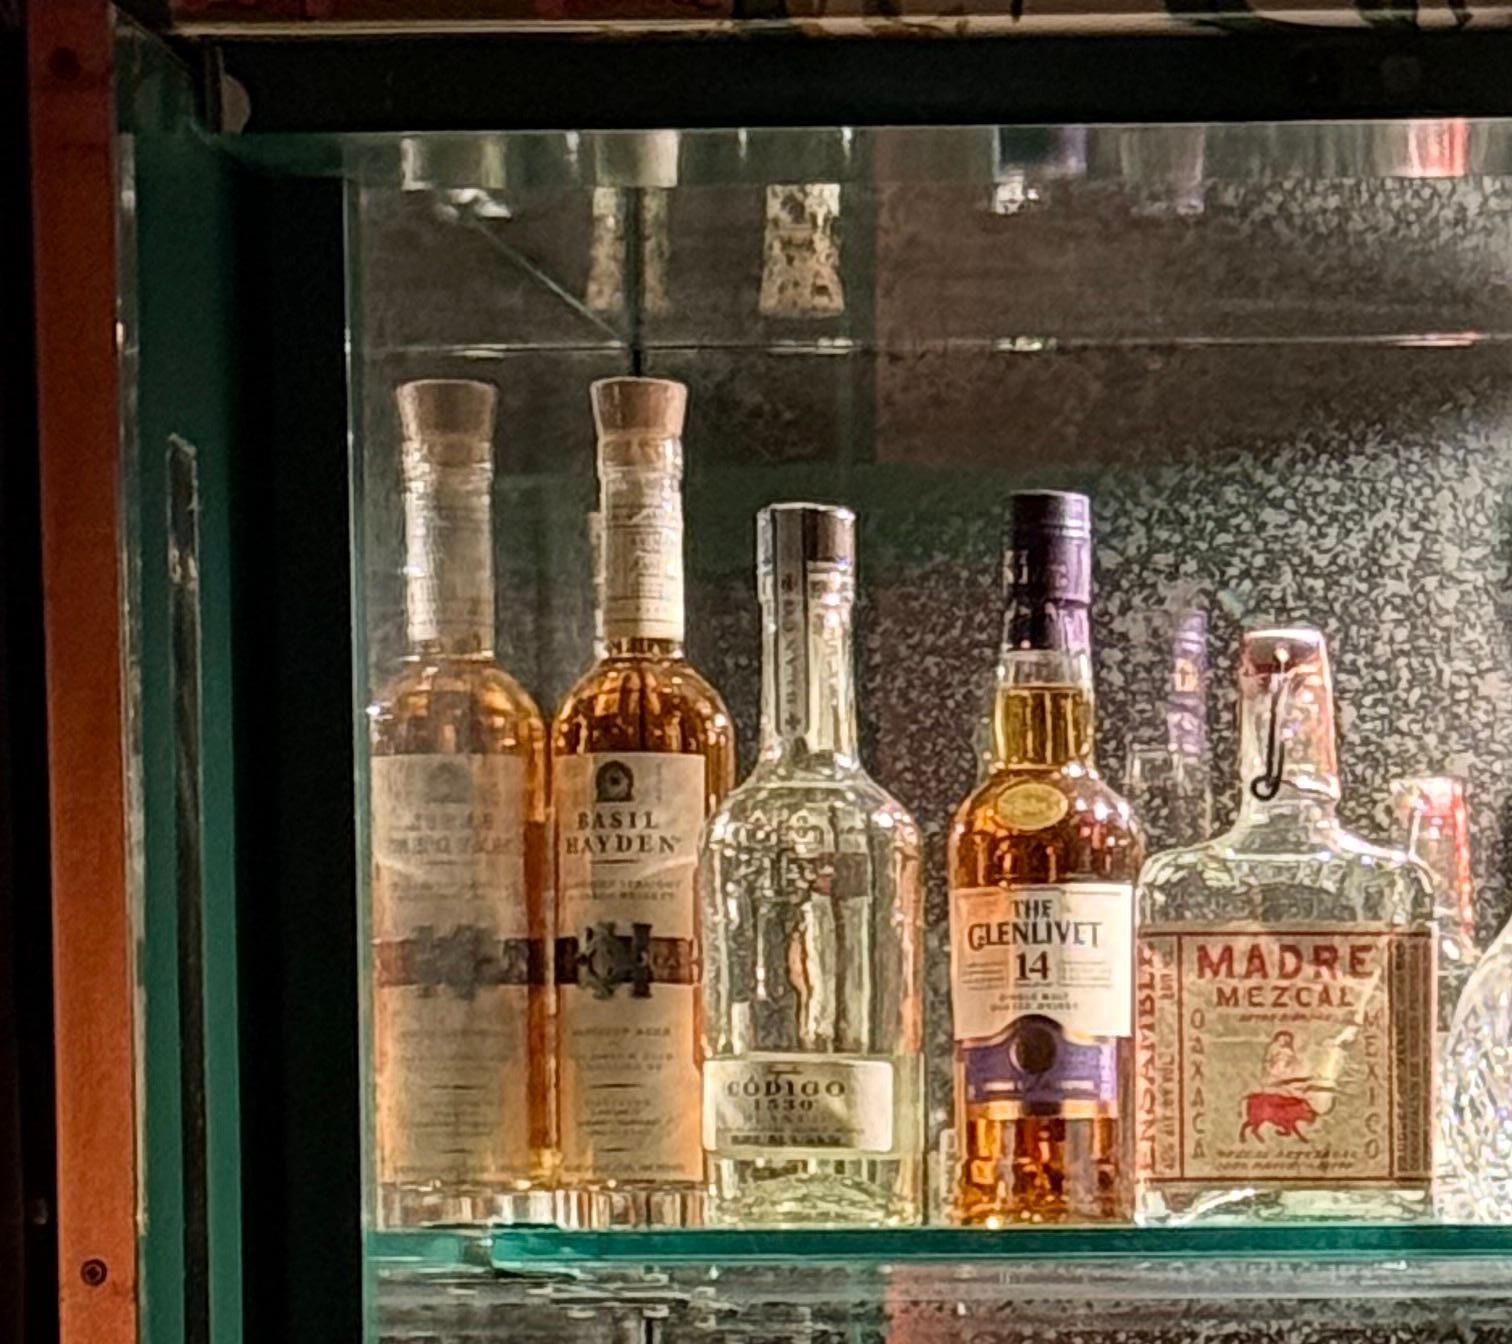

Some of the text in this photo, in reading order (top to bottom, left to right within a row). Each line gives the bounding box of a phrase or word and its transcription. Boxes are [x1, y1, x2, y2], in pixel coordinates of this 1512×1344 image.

[577, 810, 660, 831] BASIL
[565, 832, 676, 855] HAYDEN
[1011, 899, 1053, 918] THE
[967, 920, 1103, 952] GLENLIVET
[1015, 950, 1049, 981] 14
[1196, 943, 1377, 980] MADRE
[1215, 986, 1355, 1009] MEZCAL
[1189, 1009, 1207, 1161] OAXACA
[1362, 1008, 1386, 1161] MEXICO
